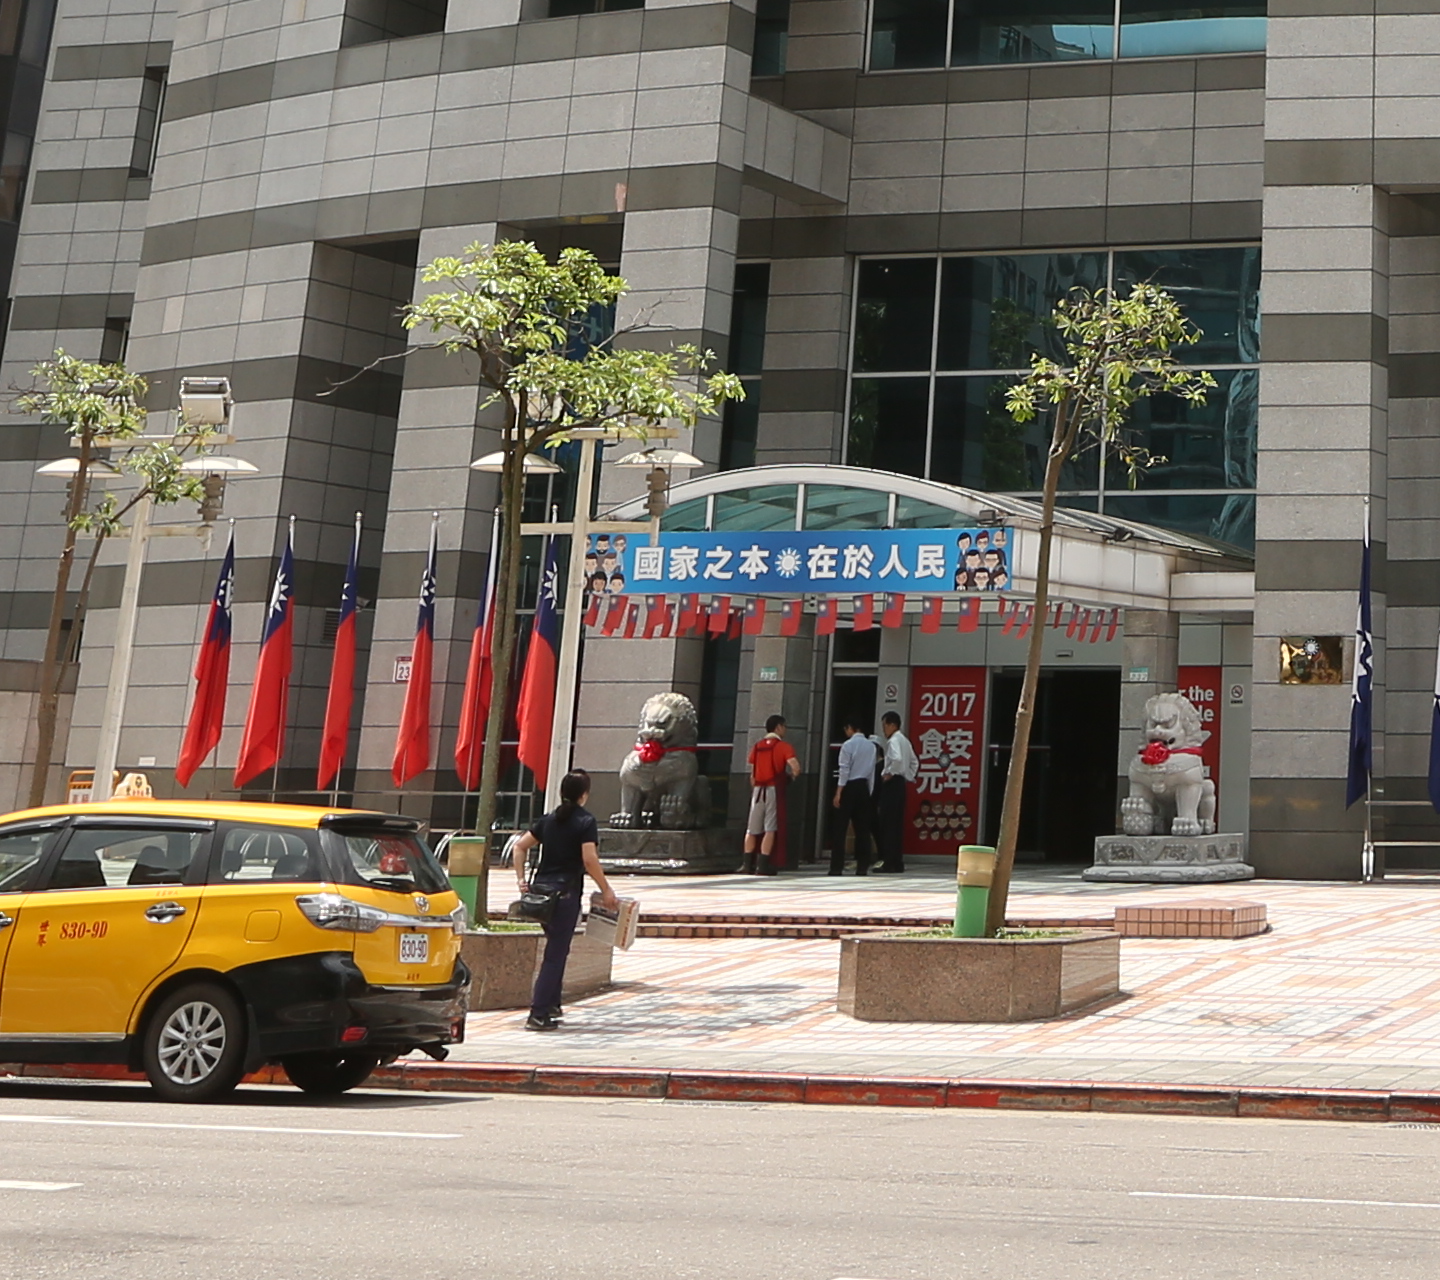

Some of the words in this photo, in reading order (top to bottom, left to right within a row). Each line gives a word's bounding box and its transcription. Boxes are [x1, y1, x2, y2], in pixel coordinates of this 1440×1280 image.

[633, 545, 770, 581] 國家之本
[807, 543, 947, 580] 在於人民
[919, 692, 977, 717] 2017
[1189, 686, 1215, 701] the
[918, 728, 974, 760] 食安
[916, 762, 972, 795] 元年
[60, 921, 108, 940] 830-9D
[402, 940, 428, 958] 830-9D
